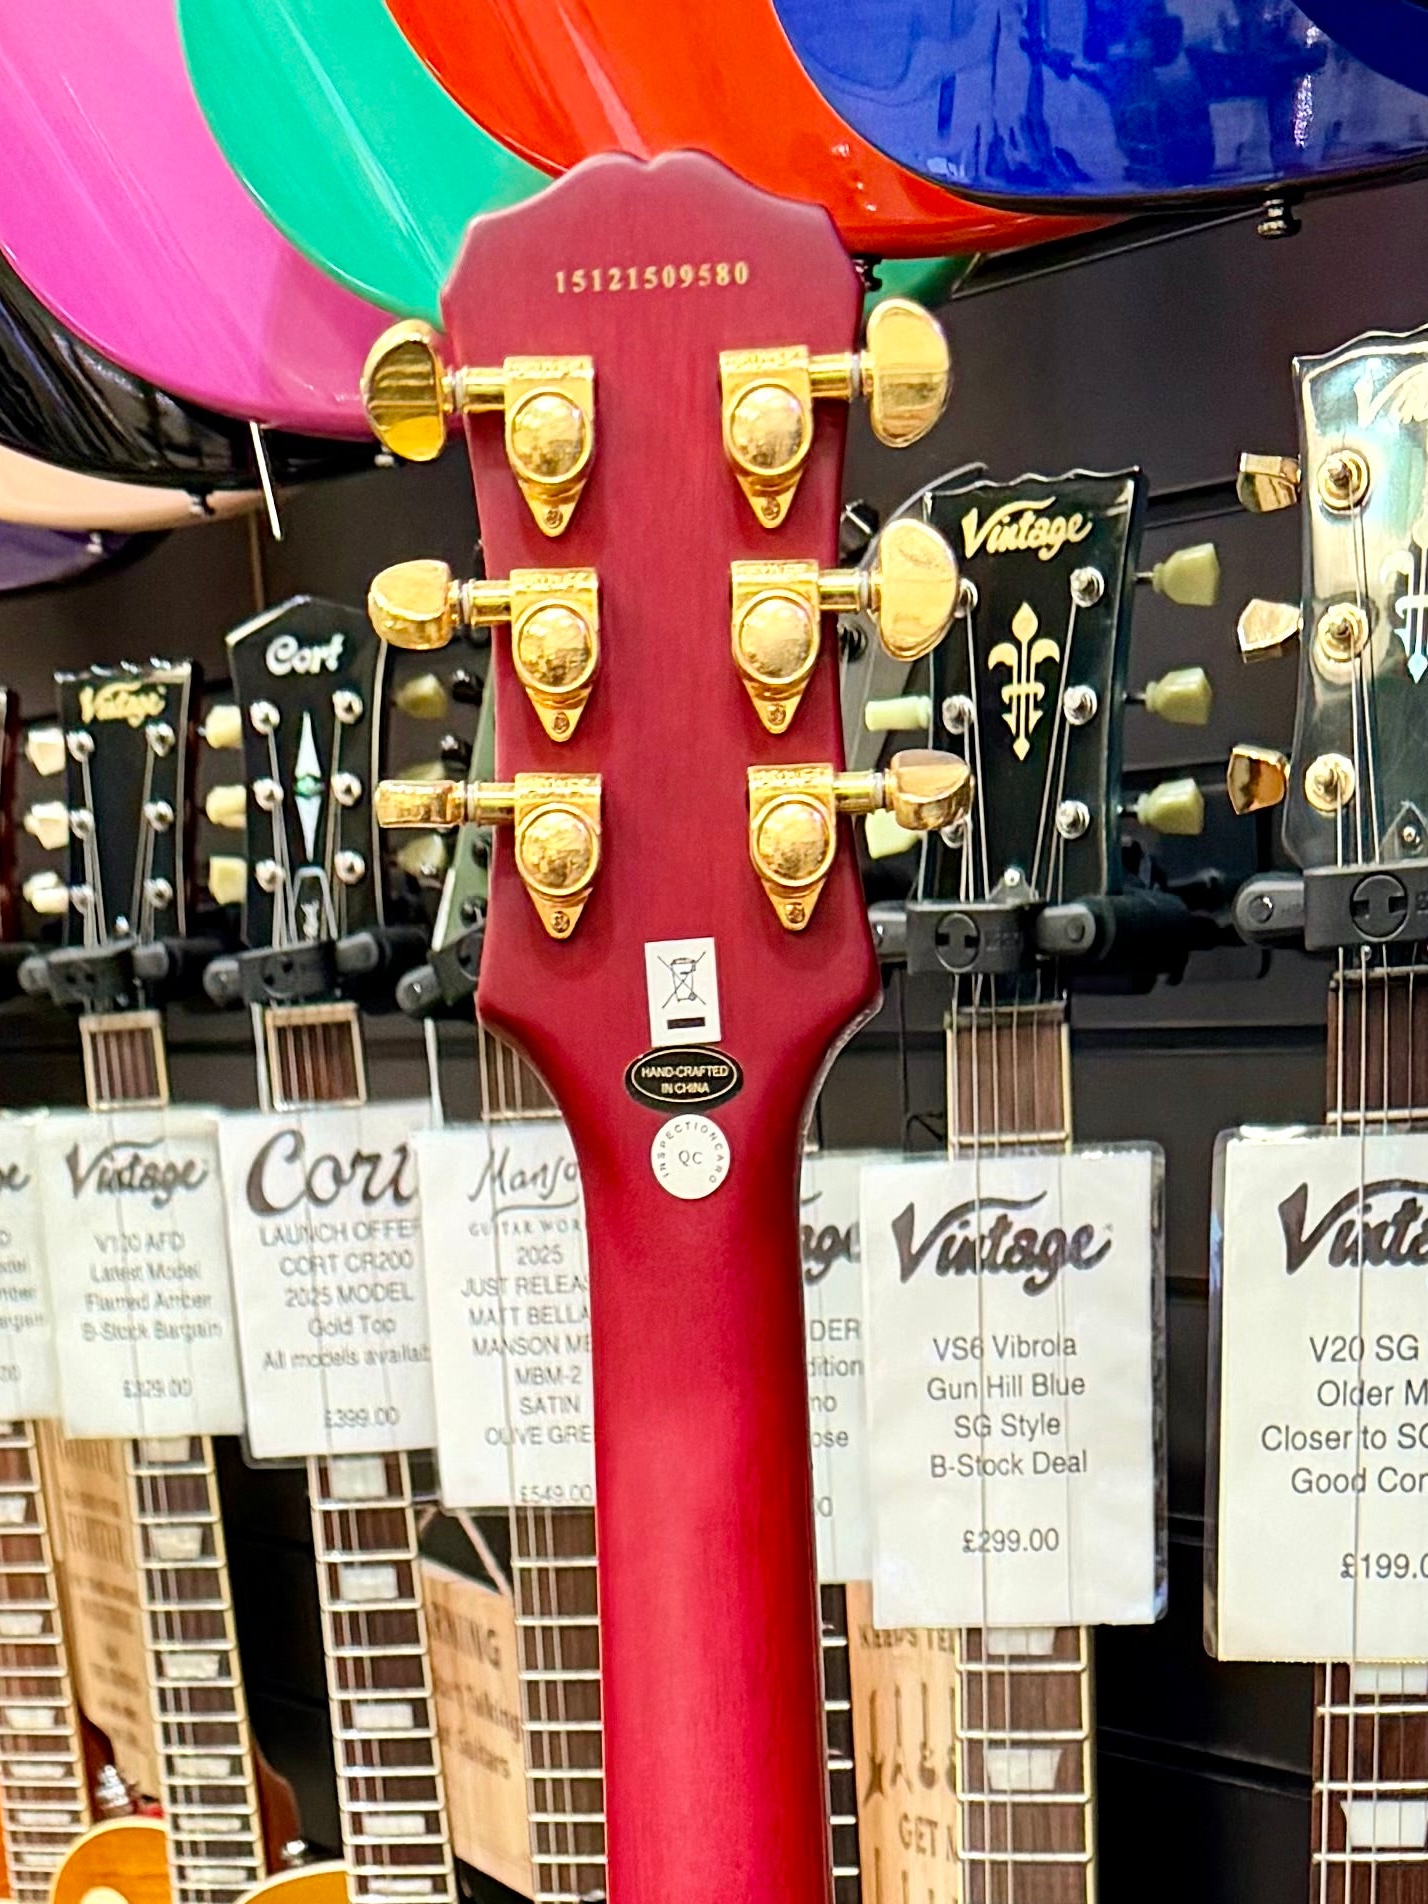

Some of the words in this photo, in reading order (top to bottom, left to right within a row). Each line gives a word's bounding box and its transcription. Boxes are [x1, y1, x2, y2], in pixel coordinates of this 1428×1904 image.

[554, 262, 749, 295] 15121509580
[961, 496, 1092, 562] Vintage
[265, 632, 345, 676] Cort
[641, 1065, 728, 1078] HAND-CRAFTED
[661, 1083, 673, 1094] IN
[674, 1082, 710, 1094] CHINA
[678, 1150, 703, 1166] QC
[65, 1136, 210, 1209] Vintage
[467, 1146, 579, 1202] Manso
[259, 1221, 349, 1247] LAUNCH
[539, 1219, 583, 1236] WOR
[516, 1245, 564, 1266] 2025
[891, 1189, 1113, 1298] Vintage
[280, 1254, 339, 1277] CORT
[336, 1283, 415, 1303] MODEL
[460, 1277, 508, 1298] JUST
[514, 1274, 588, 1296] RELEA
[469, 1306, 523, 1327] MATT
[528, 1304, 589, 1325] BELLA
[472, 1333, 559, 1357] MANSON
[932, 1335, 986, 1362] VS6
[991, 1333, 1078, 1360] Vibrola
[1309, 1334, 1366, 1364] V20
[1374, 1334, 1420, 1363] SG
[514, 1364, 583, 1386] MBM-2
[925, 1376, 980, 1402] Gun
[986, 1375, 1023, 1400] Hill
[1032, 1372, 1087, 1397] Blue
[519, 1393, 582, 1415] SATIN
[1316, 1378, 1395, 1408] Older
[548, 1422, 593, 1444] GRE
[953, 1415, 992, 1439] SG
[1000, 1413, 1061, 1441] Style
[1260, 1423, 1354, 1453] Closer
[1359, 1425, 1387, 1451] to
[929, 1452, 1024, 1479] B-Stock
[1032, 1449, 1089, 1475] Deal
[1290, 1466, 1367, 1495] Good
[962, 1527, 1060, 1553] £299.00
[898, 1812, 940, 1856] GET
